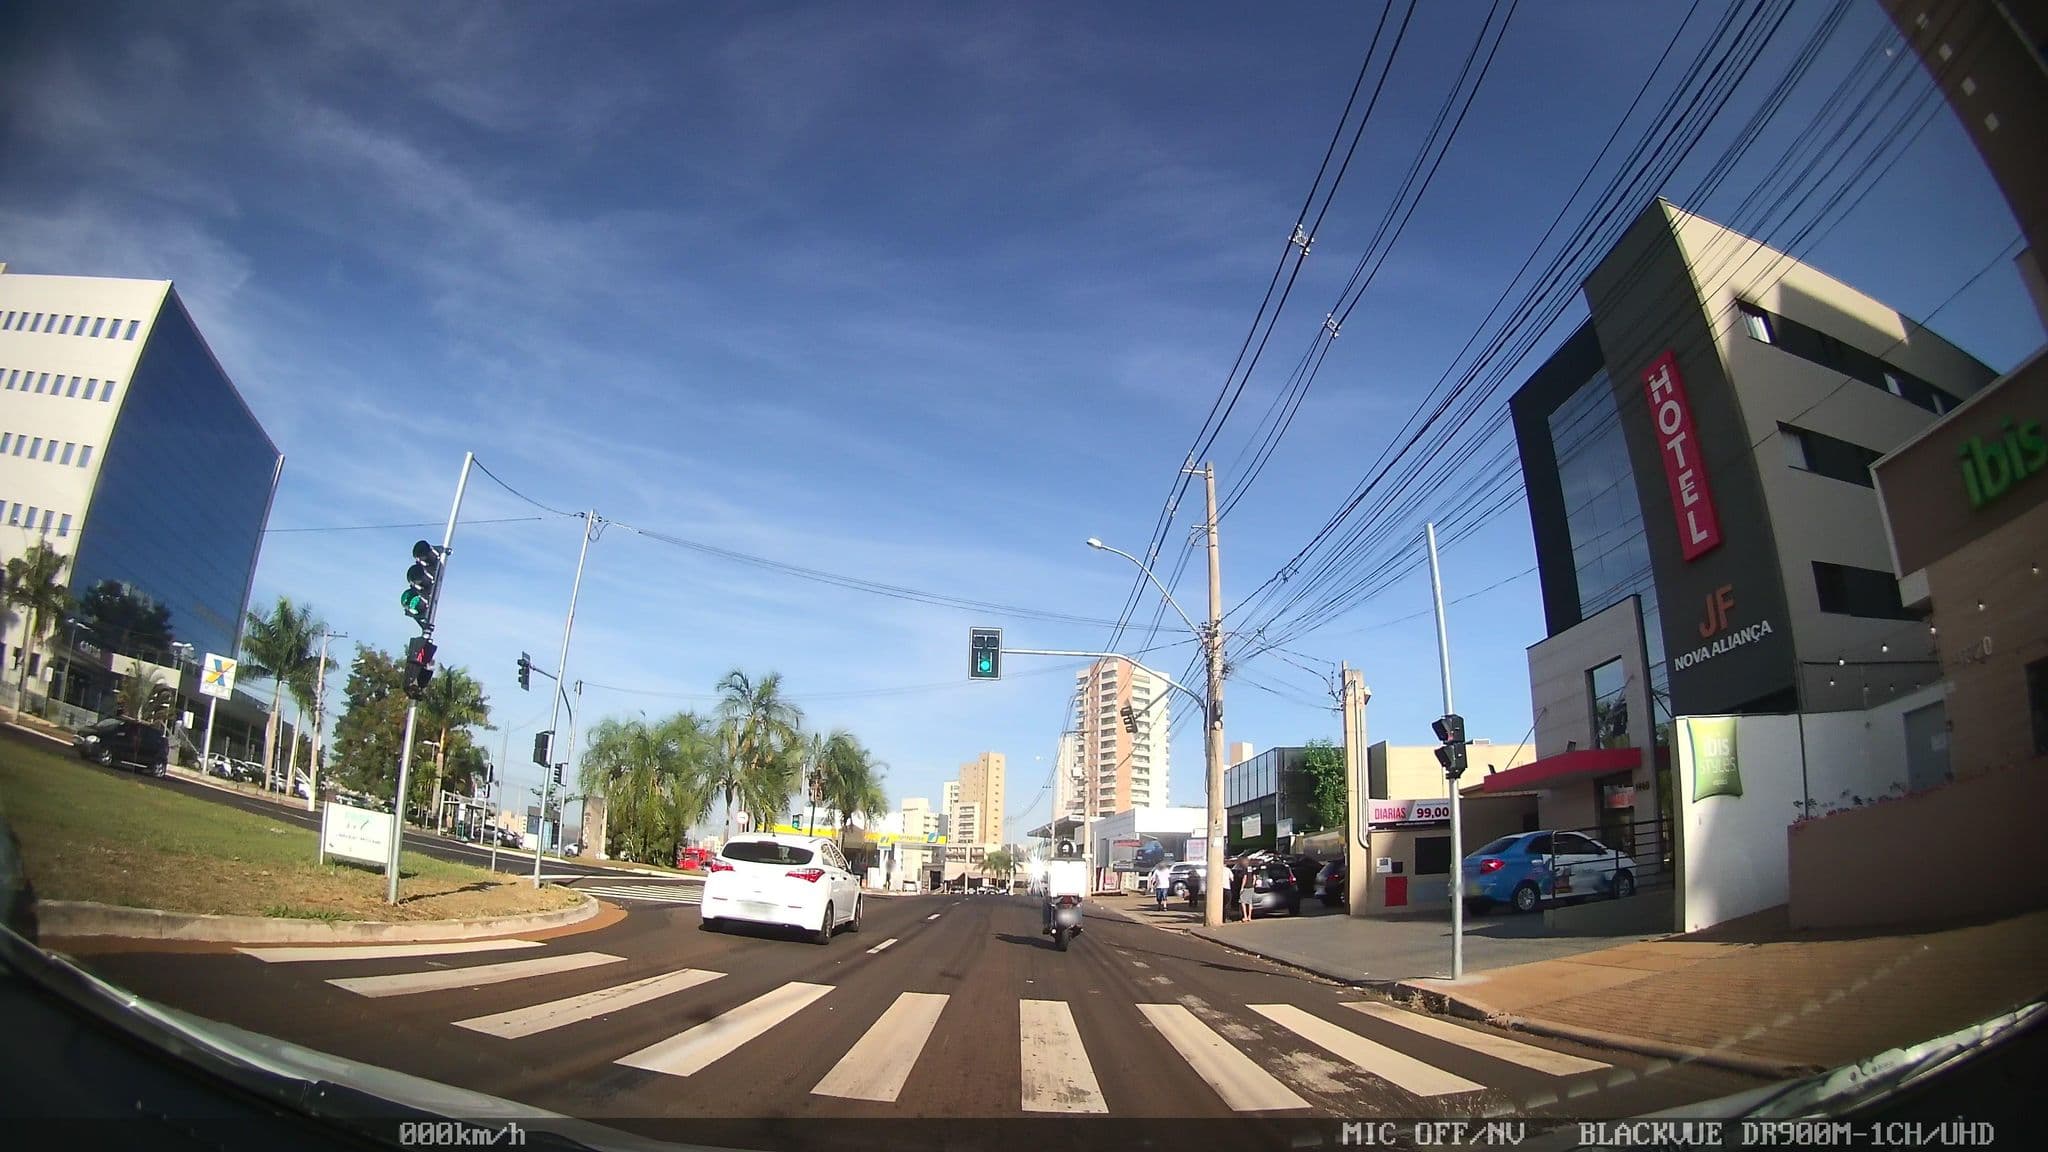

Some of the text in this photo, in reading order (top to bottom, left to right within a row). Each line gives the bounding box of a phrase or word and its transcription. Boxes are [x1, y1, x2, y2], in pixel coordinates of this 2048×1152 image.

[1648, 364, 1708, 545] HOTEL
[1959, 416, 2048, 506] ibis
[1699, 585, 1736, 638] JF
[1674, 620, 1773, 671] NOVA ALIANÇA
[1417, 807, 1449, 819] 99,00
